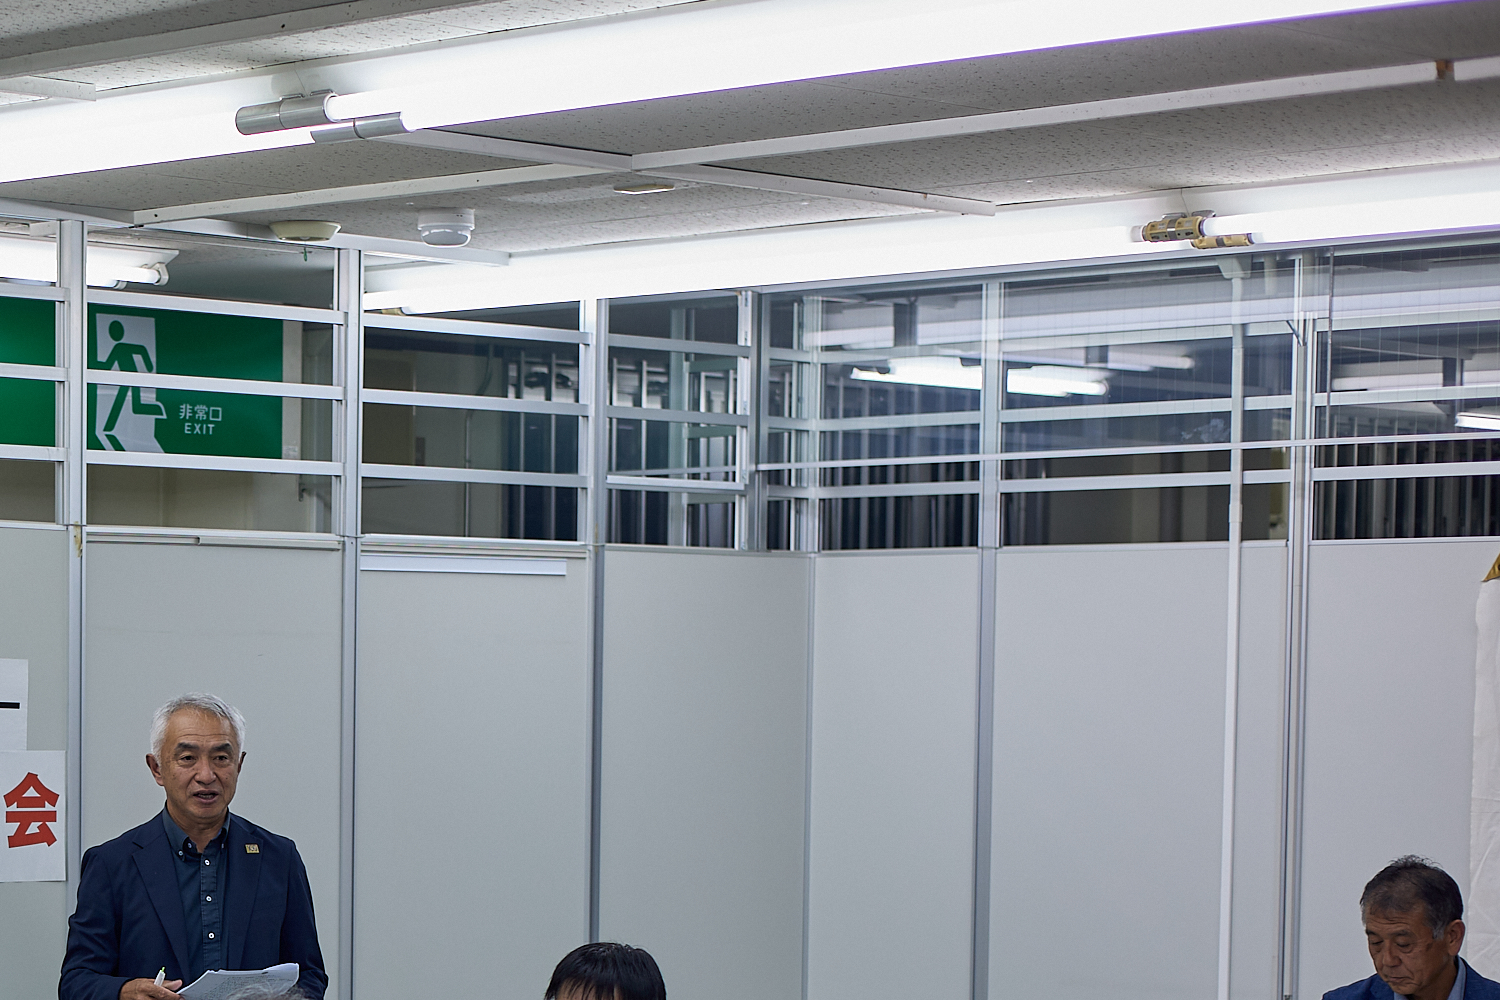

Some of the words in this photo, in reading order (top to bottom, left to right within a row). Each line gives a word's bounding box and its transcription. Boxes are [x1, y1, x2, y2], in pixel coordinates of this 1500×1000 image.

[179, 403, 222, 421] 非常口
[184, 423, 215, 435] EXIT
